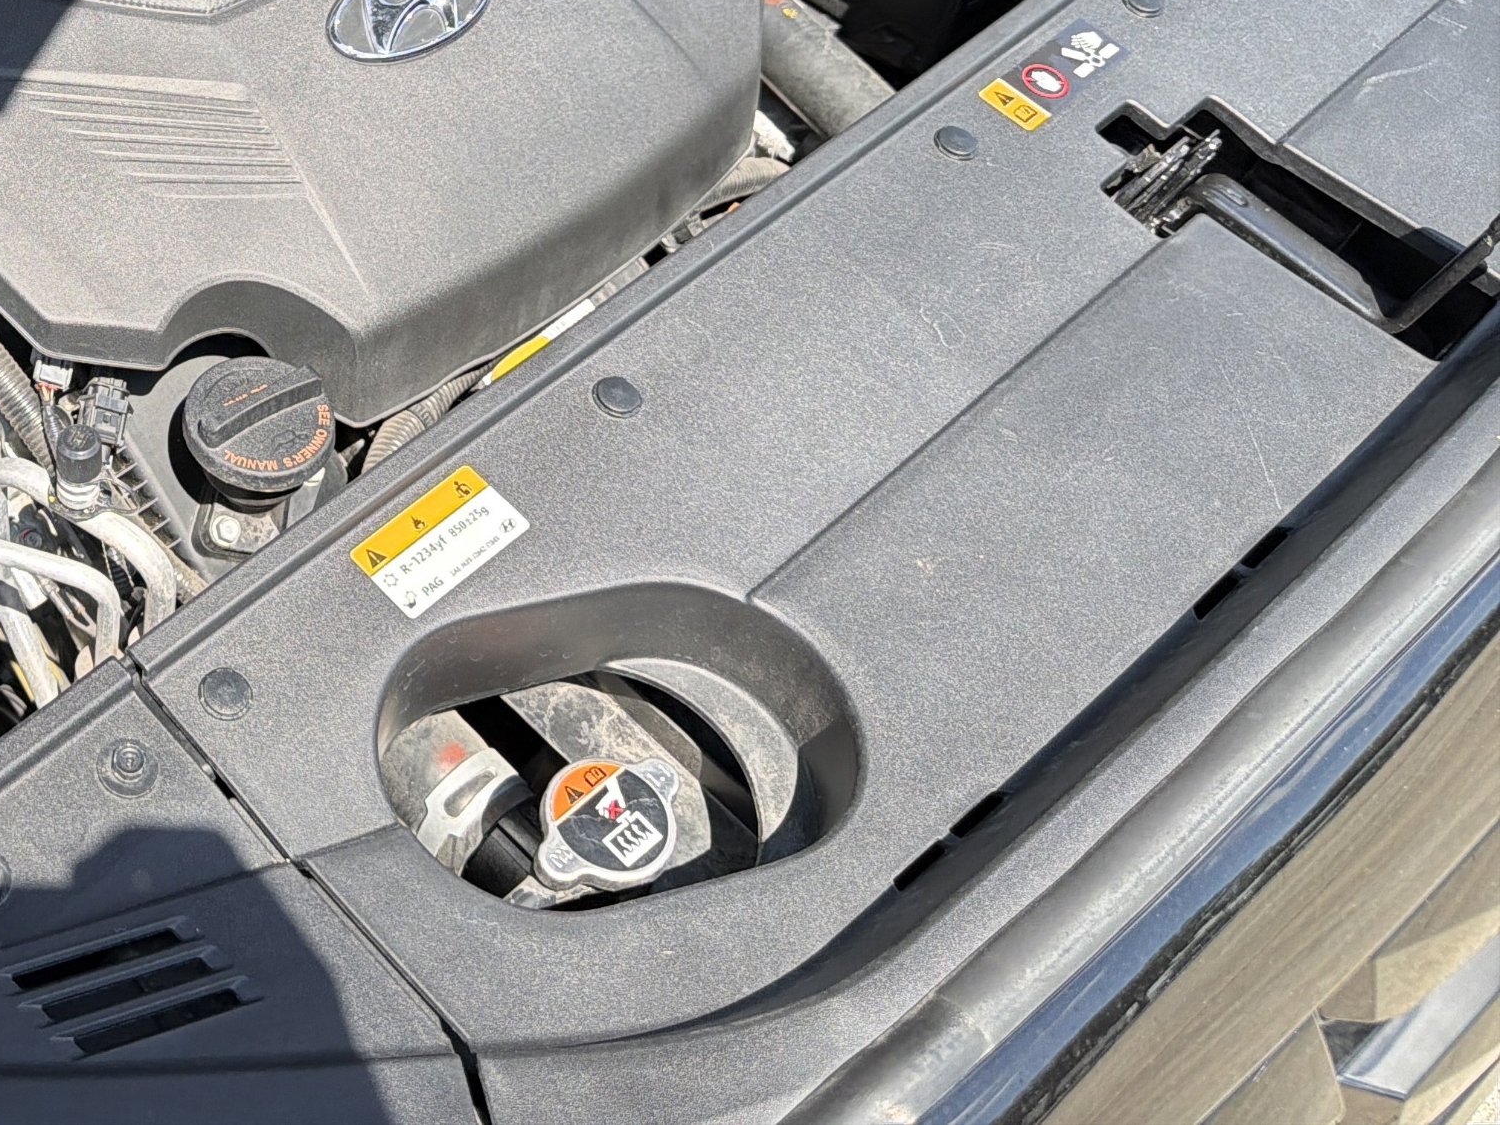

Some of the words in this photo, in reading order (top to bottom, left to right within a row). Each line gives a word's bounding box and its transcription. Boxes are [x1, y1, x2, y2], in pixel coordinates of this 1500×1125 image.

[316, 404, 331, 426] SEE
[282, 428, 328, 468] OWNER'S
[224, 449, 279, 471] MANUAL
[400, 534, 448, 575] R-1234yf
[447, 506, 490, 537] 850±25g
[421, 576, 445, 596] PAG
